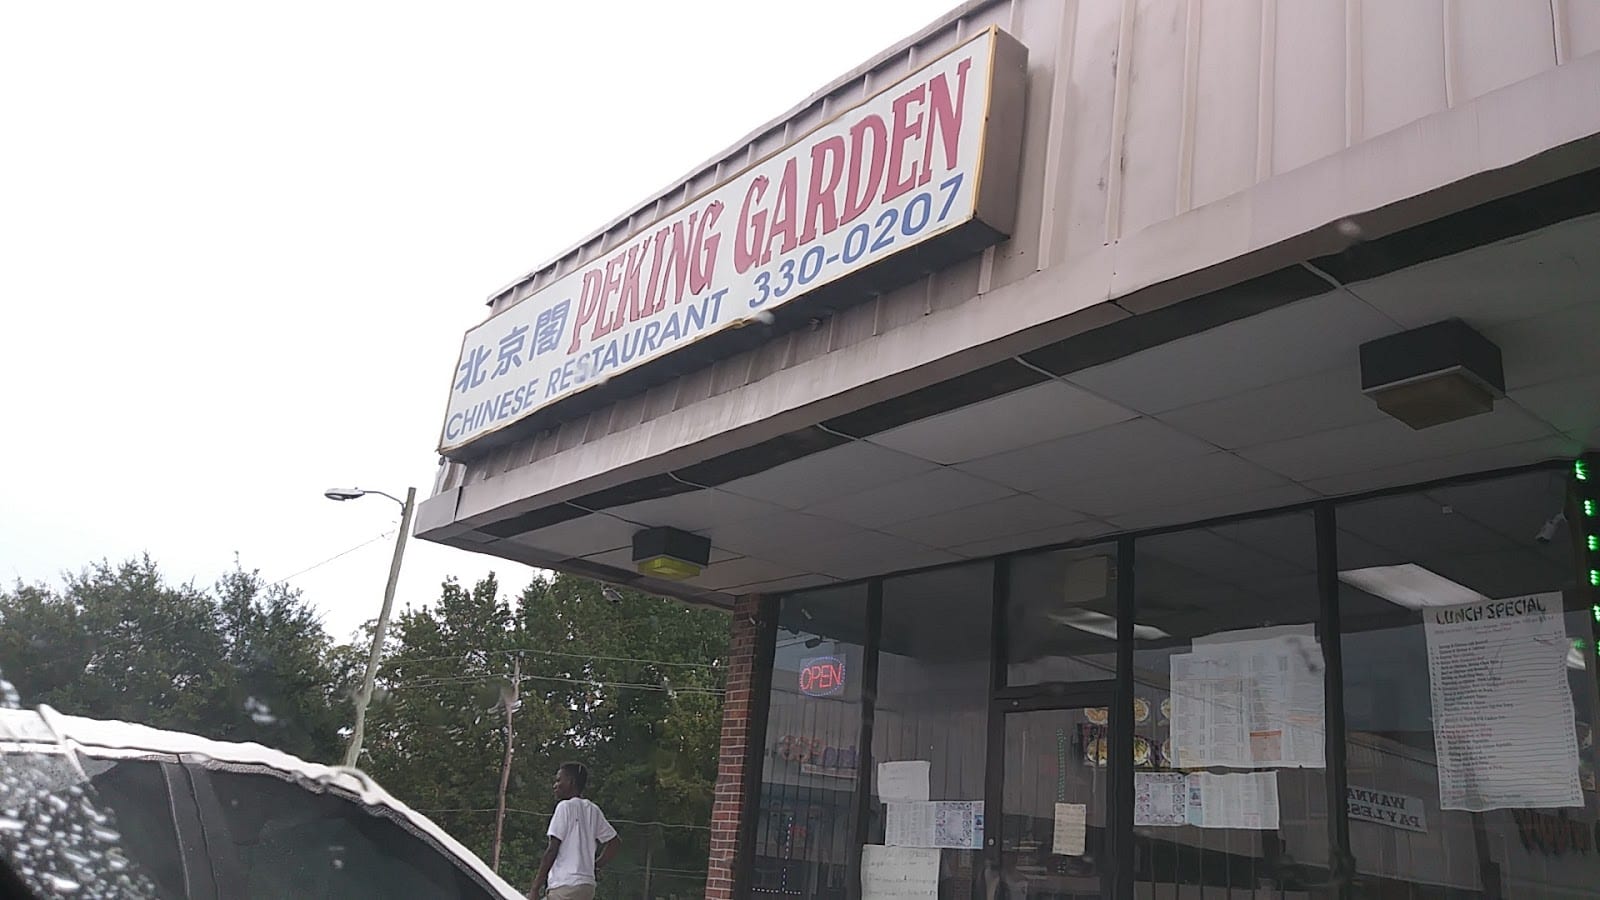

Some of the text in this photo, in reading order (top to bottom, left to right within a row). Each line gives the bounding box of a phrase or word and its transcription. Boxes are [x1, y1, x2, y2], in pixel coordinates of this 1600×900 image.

[566, 56, 972, 355] PEKING GARDEN
[445, 172, 964, 441] CHINESE RESTAURANT 330-0207
[455, 298, 571, 394] 北京閣
[1435, 605, 1483, 625] LUNCH
[1486, 597, 1546, 619] SPECIAL
[800, 663, 842, 690] OPEN
